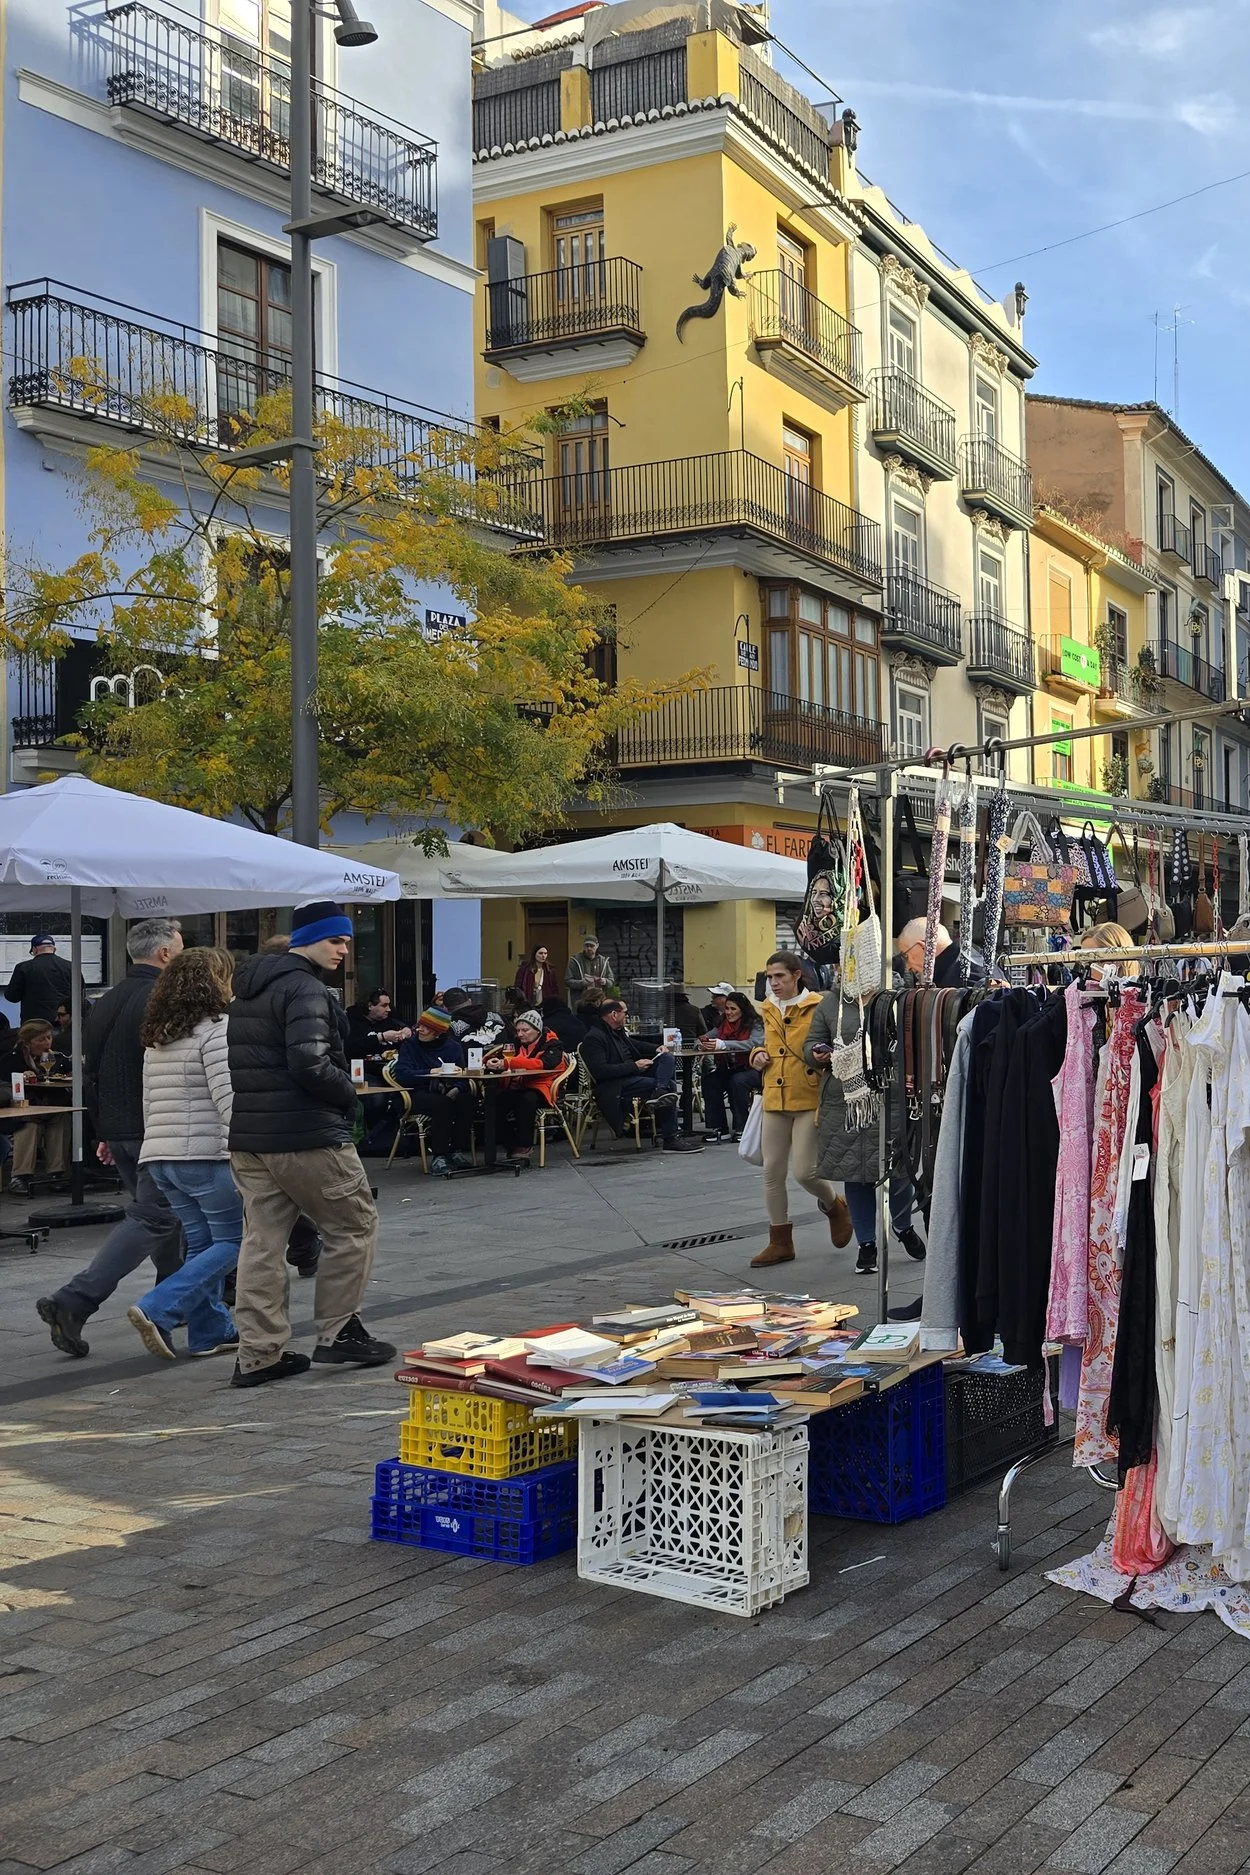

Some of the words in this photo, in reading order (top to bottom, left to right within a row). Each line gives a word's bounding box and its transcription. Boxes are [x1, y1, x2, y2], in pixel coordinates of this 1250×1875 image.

[430, 611, 461, 627] PLAZA
[766, 835, 781, 855] EL
[530, 1380, 552, 1393] cocina
